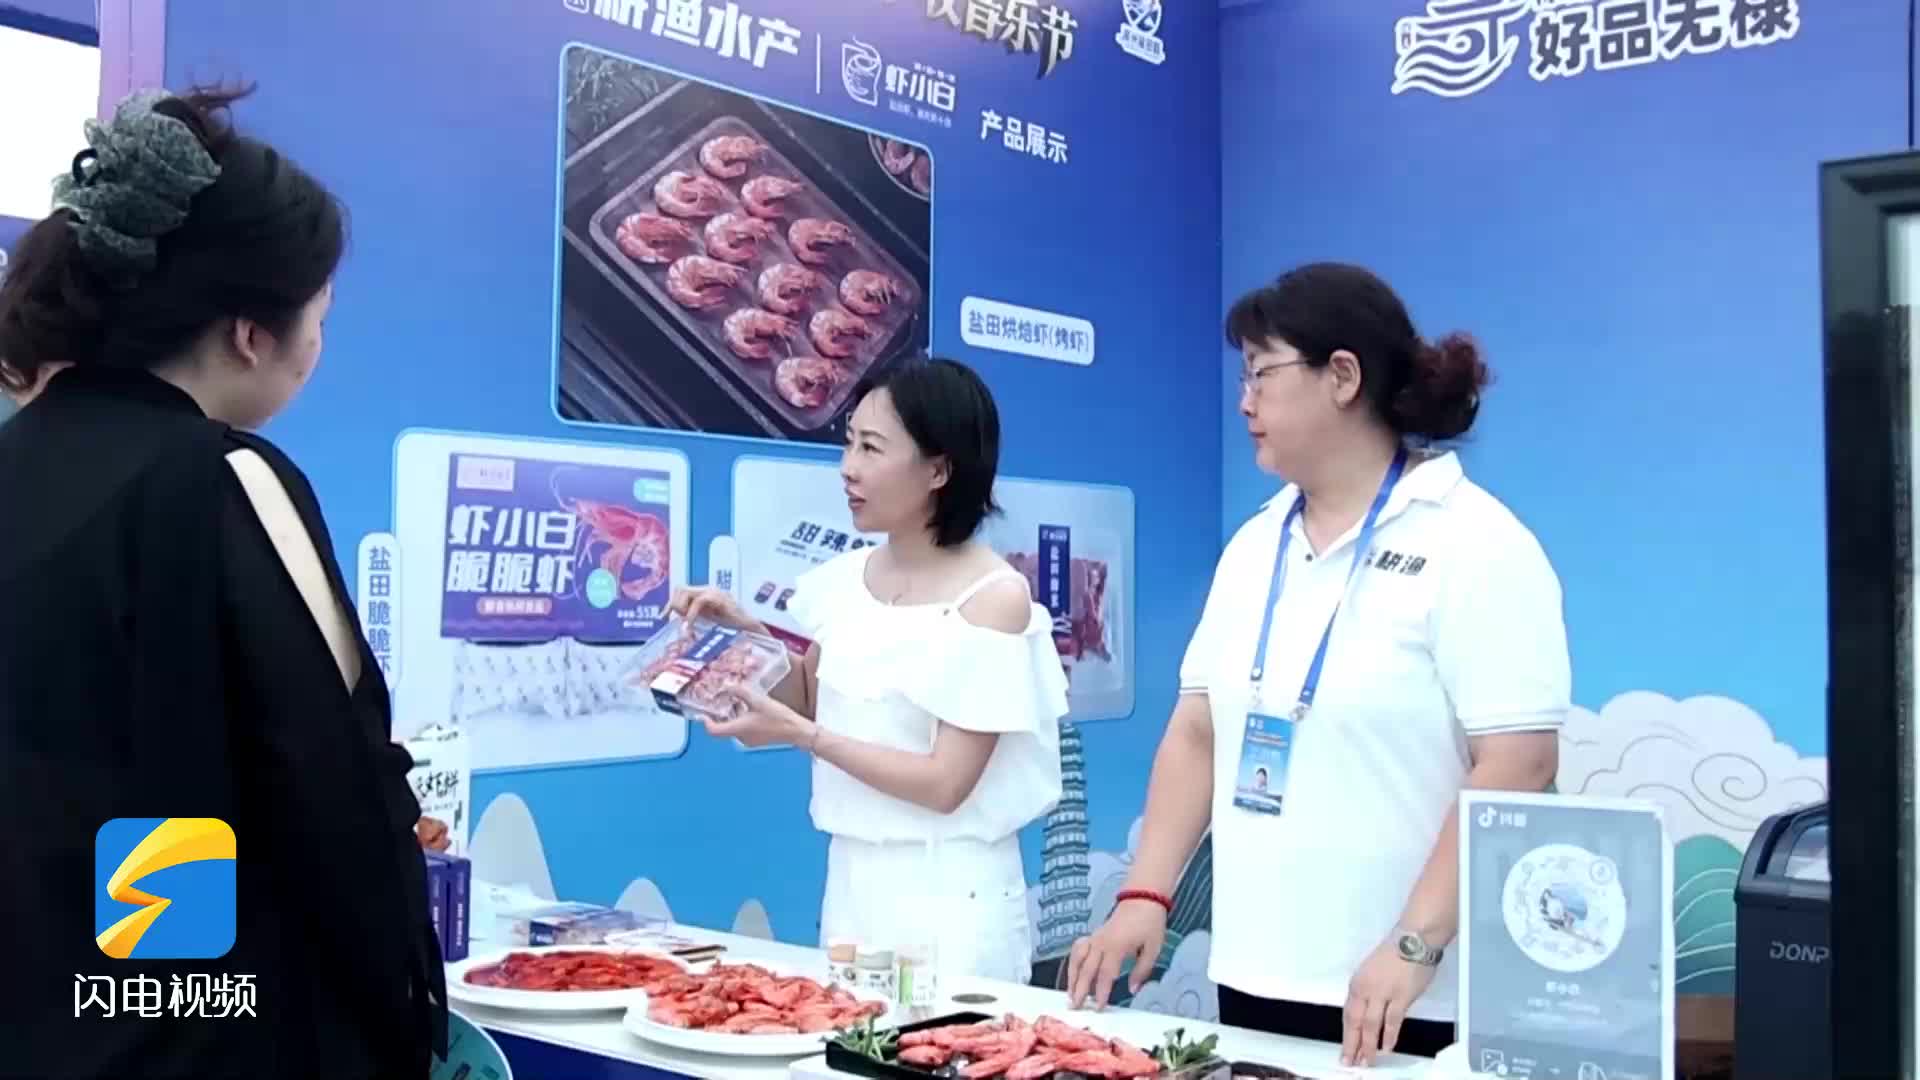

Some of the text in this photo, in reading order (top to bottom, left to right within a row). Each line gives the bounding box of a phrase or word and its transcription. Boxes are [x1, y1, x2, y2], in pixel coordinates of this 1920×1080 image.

[885, 64, 956, 112] 虾小白
[981, 108, 1068, 164] 产品展示
[447, 504, 578, 550] 虾小白
[446, 550, 577, 594] 脆脆虾
